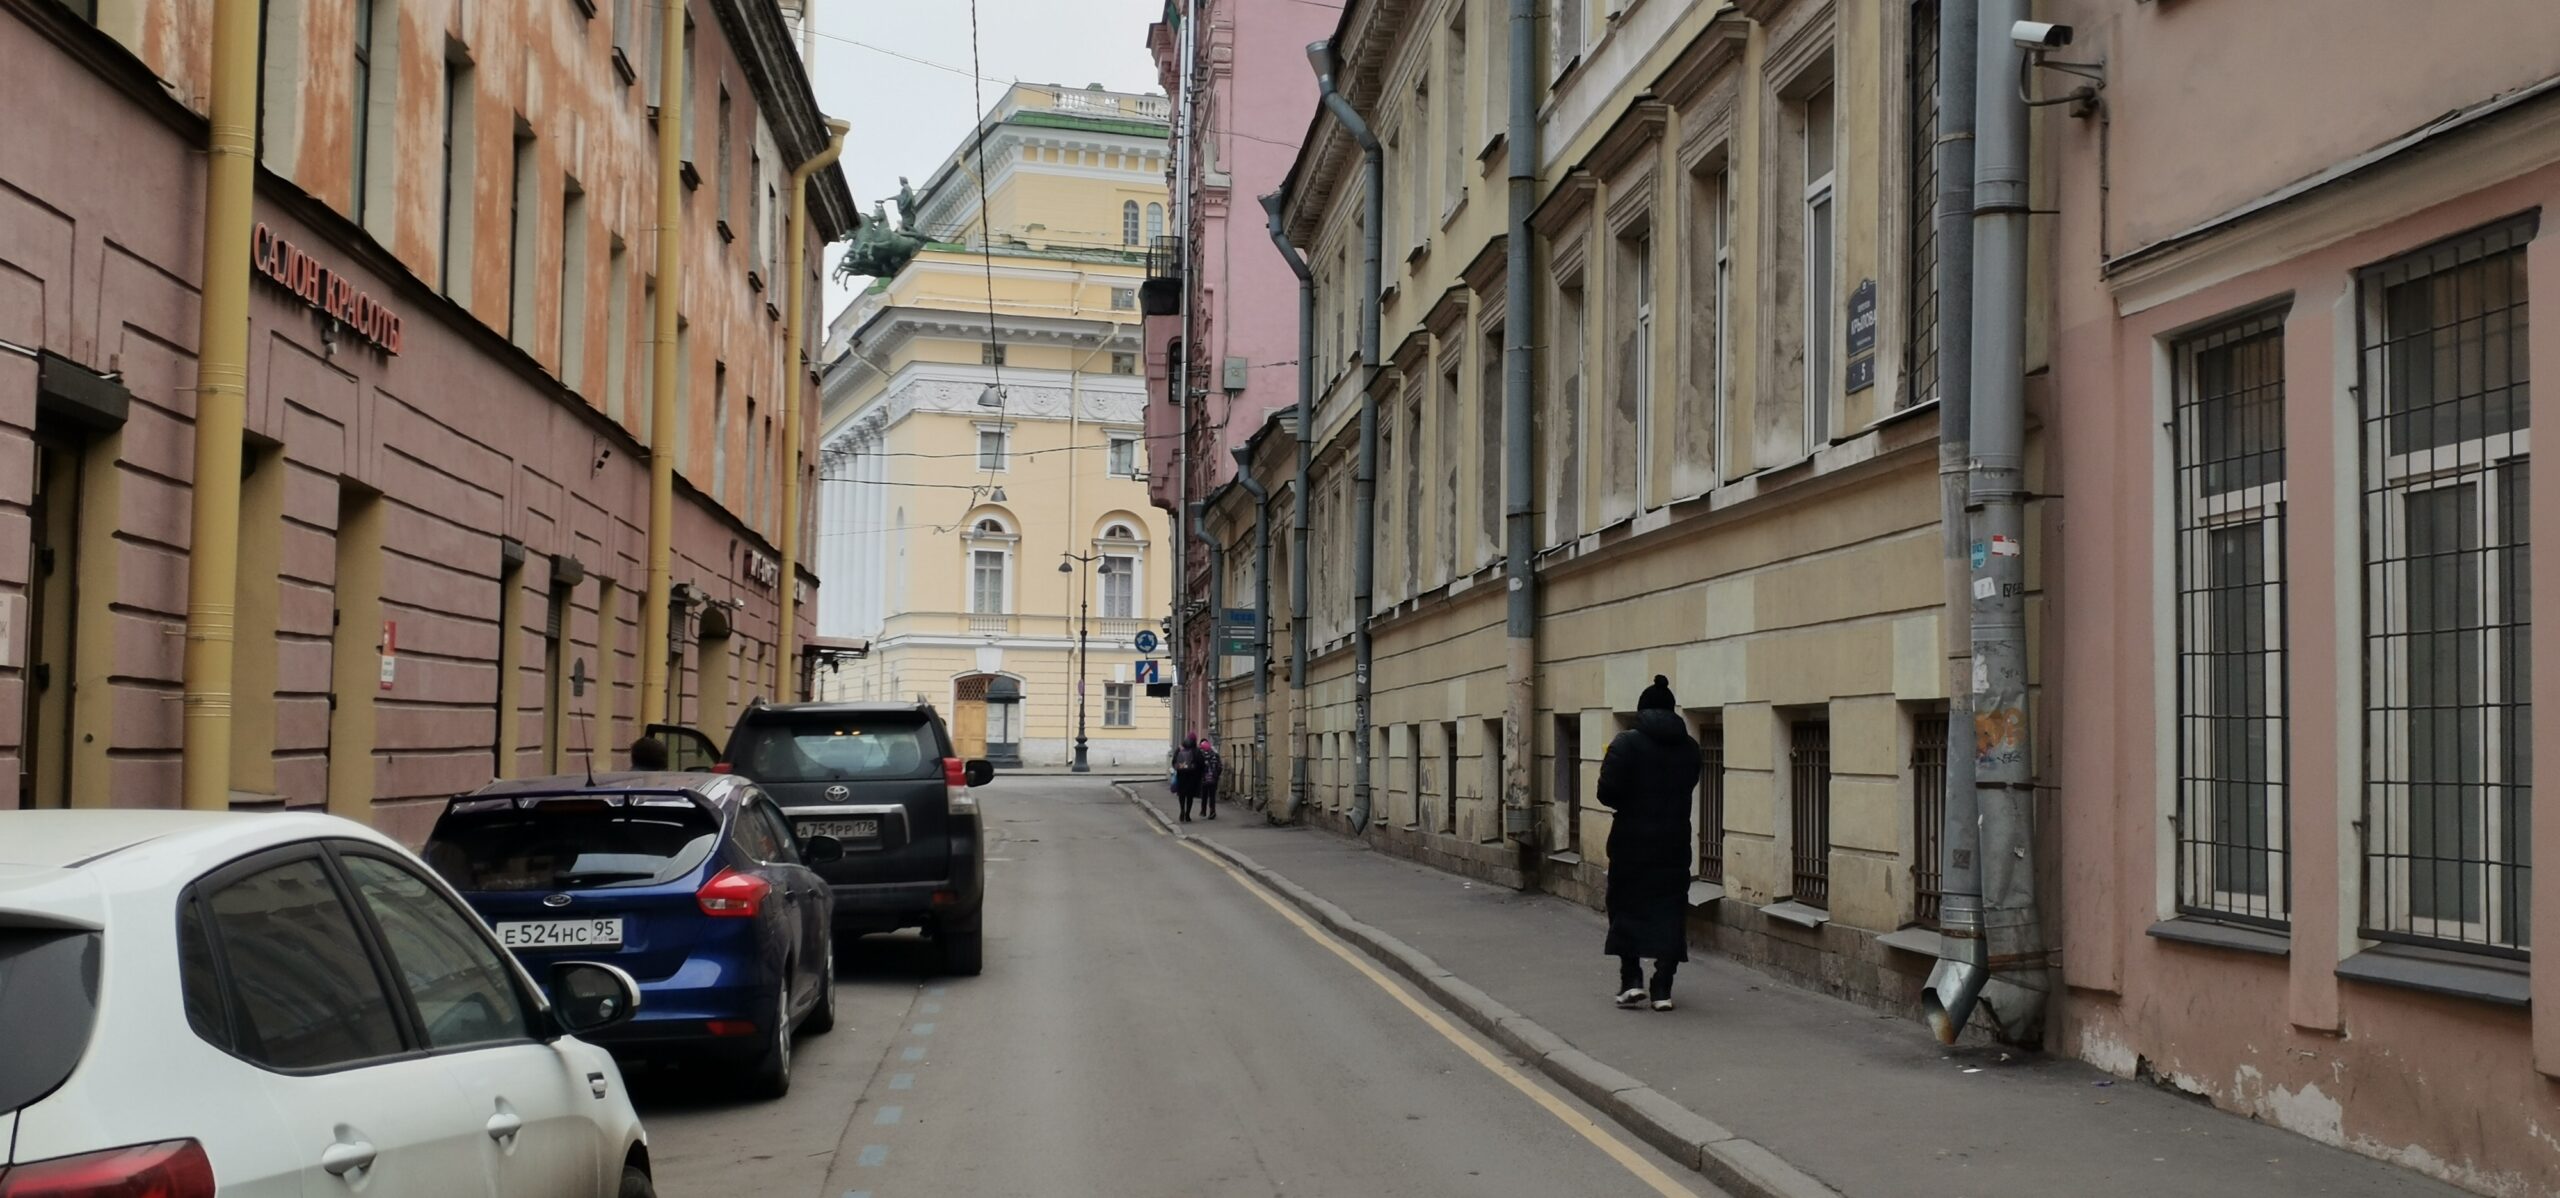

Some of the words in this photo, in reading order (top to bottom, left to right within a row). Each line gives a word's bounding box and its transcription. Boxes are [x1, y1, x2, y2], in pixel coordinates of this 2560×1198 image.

[253, 222, 320, 305] САЛОН
[325, 268, 403, 354] КРАСОТЫ
[1861, 362, 1866, 381] 5
[594, 921, 614, 936] 95
